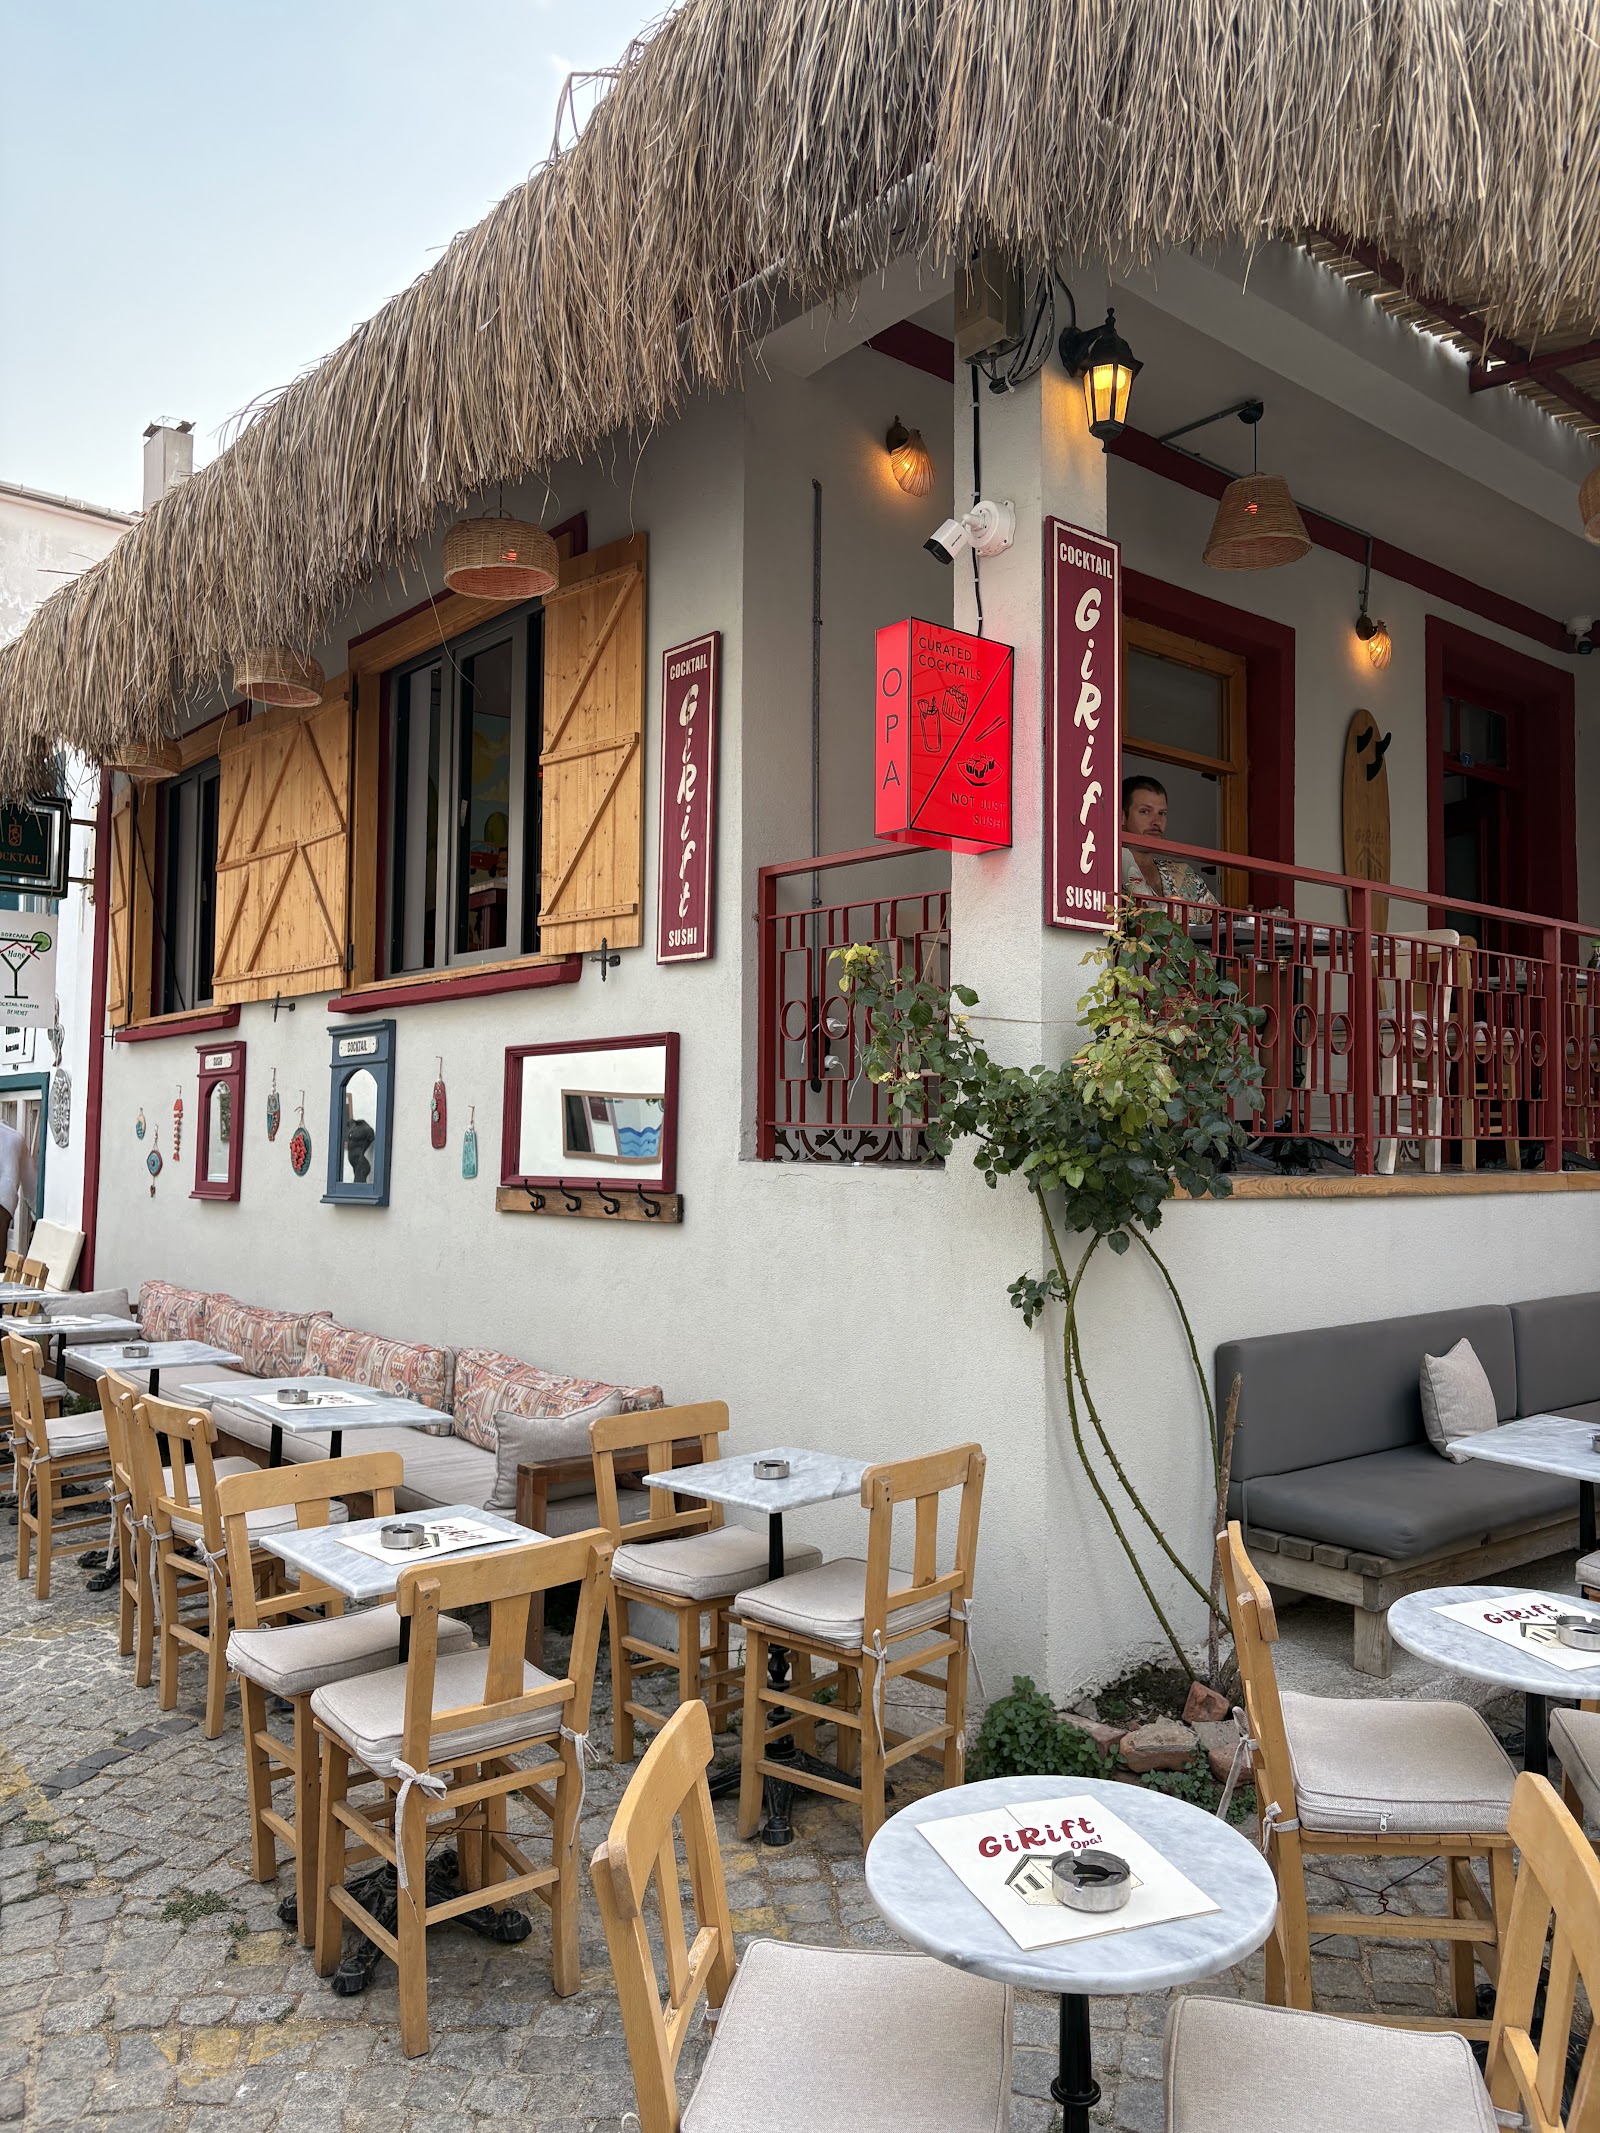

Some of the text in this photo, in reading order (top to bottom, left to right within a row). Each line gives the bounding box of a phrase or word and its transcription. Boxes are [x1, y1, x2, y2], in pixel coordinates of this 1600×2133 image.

[1059, 542, 1113, 579] COCKTAIL
[918, 637, 972, 661] CURATED
[669, 653, 708, 681] COCKTAIL
[918, 654, 982, 682] COCKTAILS
[882, 667, 902, 790] OPA
[1074, 587, 1102, 874] GiRift
[676, 683, 699, 918] GiRift
[951, 792, 1005, 813] NOT JUST
[974, 813, 1007, 830] SUSHI
[0, 851, 42, 865] CKTAIL
[1066, 885, 1107, 913] SUSHI
[668, 927, 697, 947] SUSHI
[1483, 1603, 1558, 1624] GiRift
[978, 1817, 1095, 1857] GiRift
[1070, 1834, 1103, 1850] Opa!
